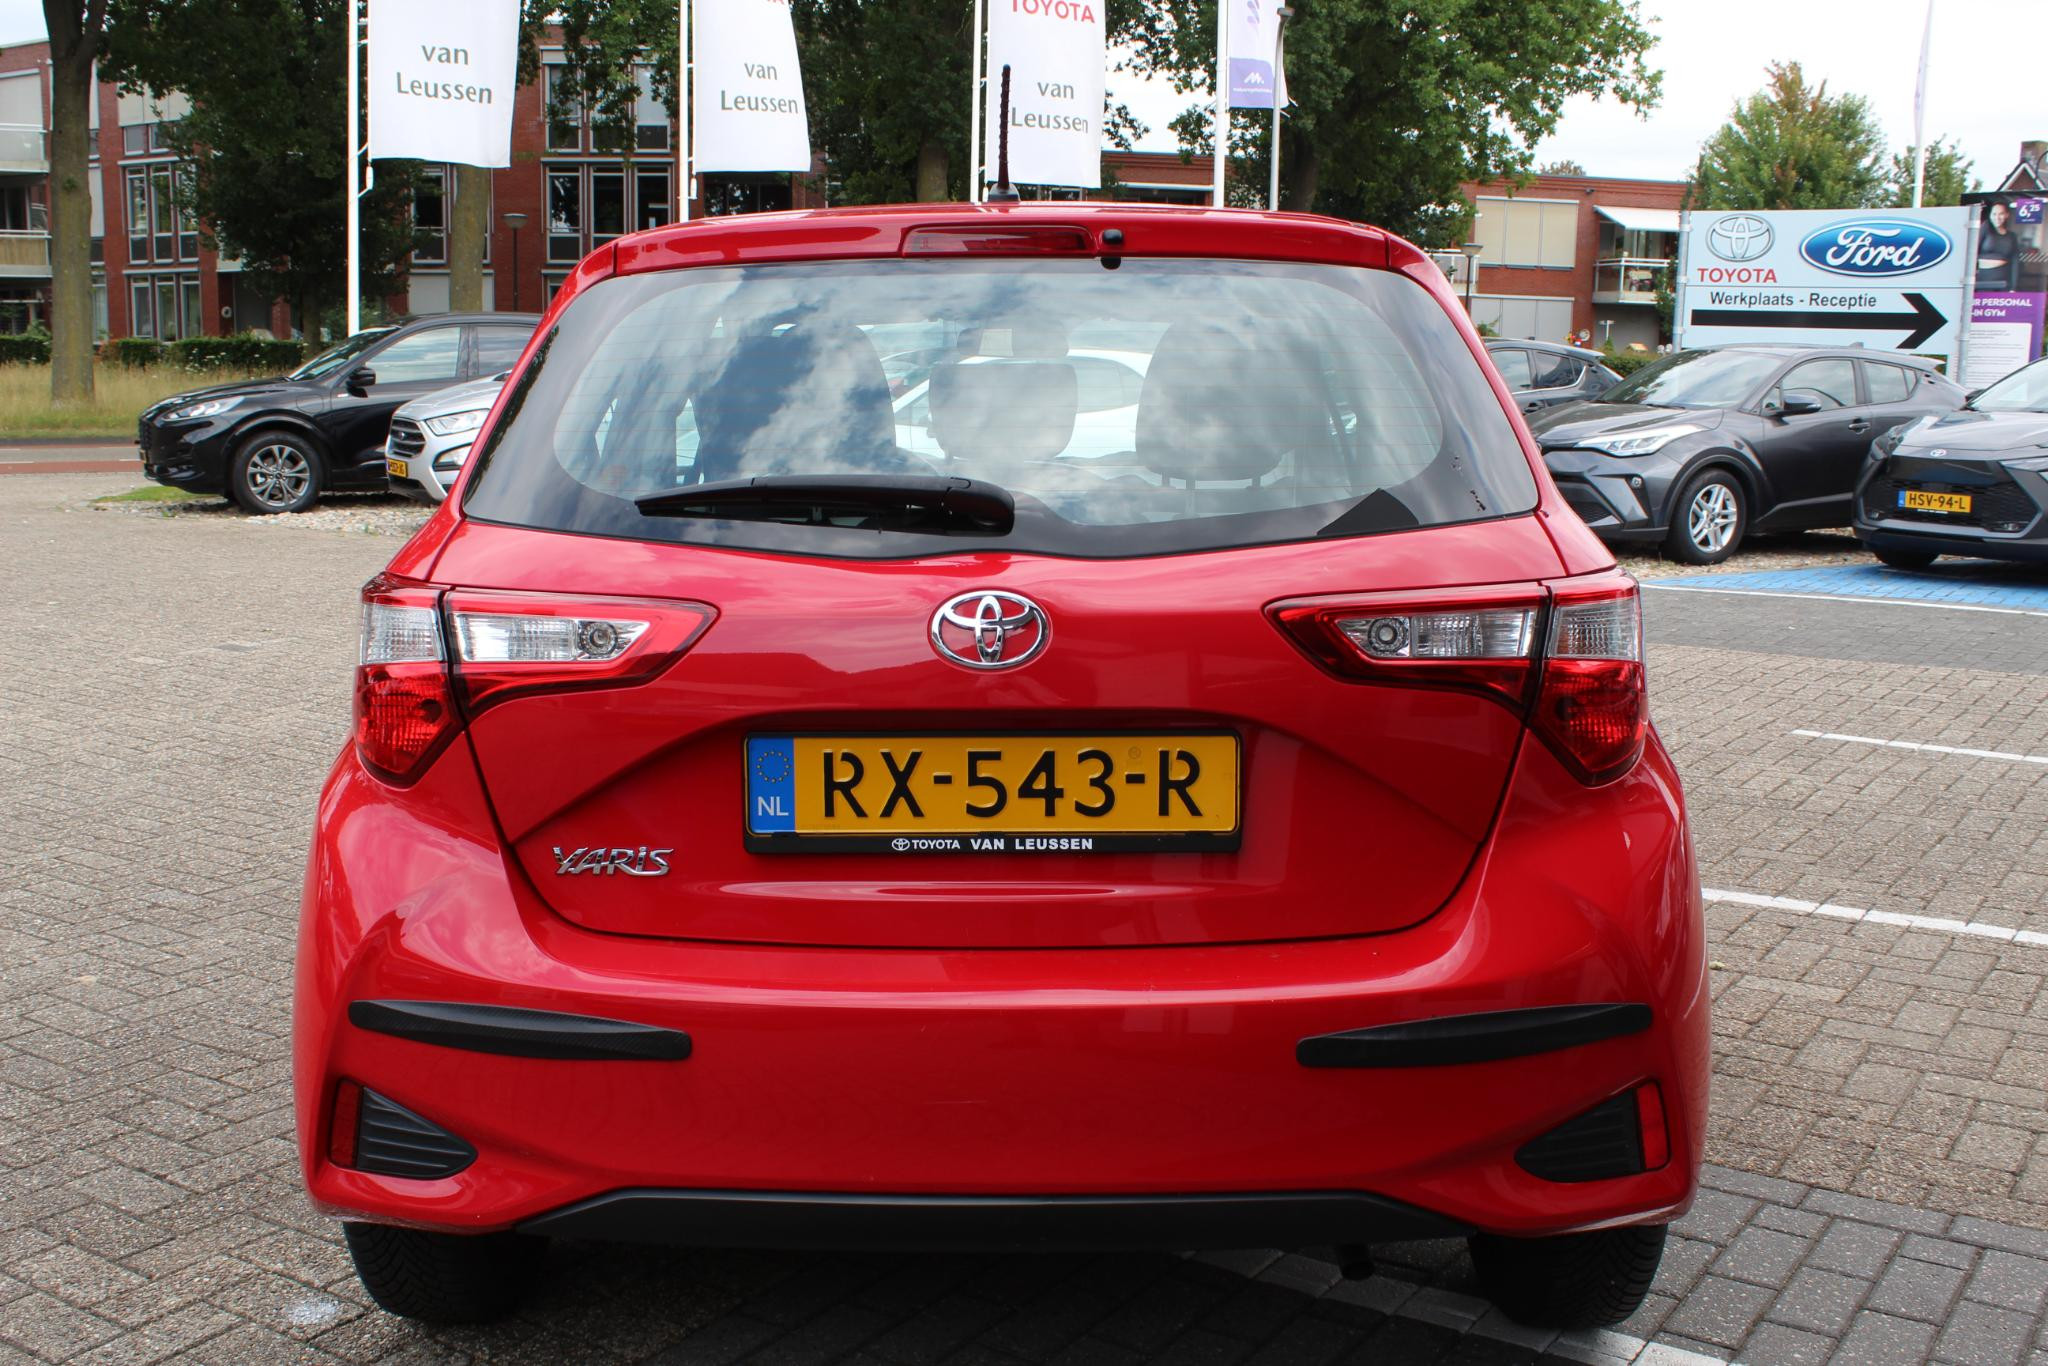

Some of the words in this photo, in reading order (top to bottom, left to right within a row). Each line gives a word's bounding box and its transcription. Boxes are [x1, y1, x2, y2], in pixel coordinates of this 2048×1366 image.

[422, 44, 469, 66] van
[744, 62, 778, 80] van
[396, 72, 493, 104] Leussen
[1037, 81, 1074, 100] van
[720, 90, 799, 114] Leussen
[1011, 107, 1089, 134] Leussen
[1826, 226, 1925, 267] Ford
[1697, 268, 1777, 284] TOYOTA
[1710, 291, 1794, 307] Werkplaats
[1808, 293, 1877, 308] Receptie
[1982, 299, 2032, 307] PERSONAL
[1984, 309, 2006, 317] GYM
[1909, 493, 1966, 509] HSV-94-L
[823, 750, 1203, 818] RX-543-R
[757, 796, 789, 817] NL
[912, 839, 960, 850] TOYOTA
[971, 838, 1005, 850] VAN
[1015, 838, 1093, 850] LEUSSEN
